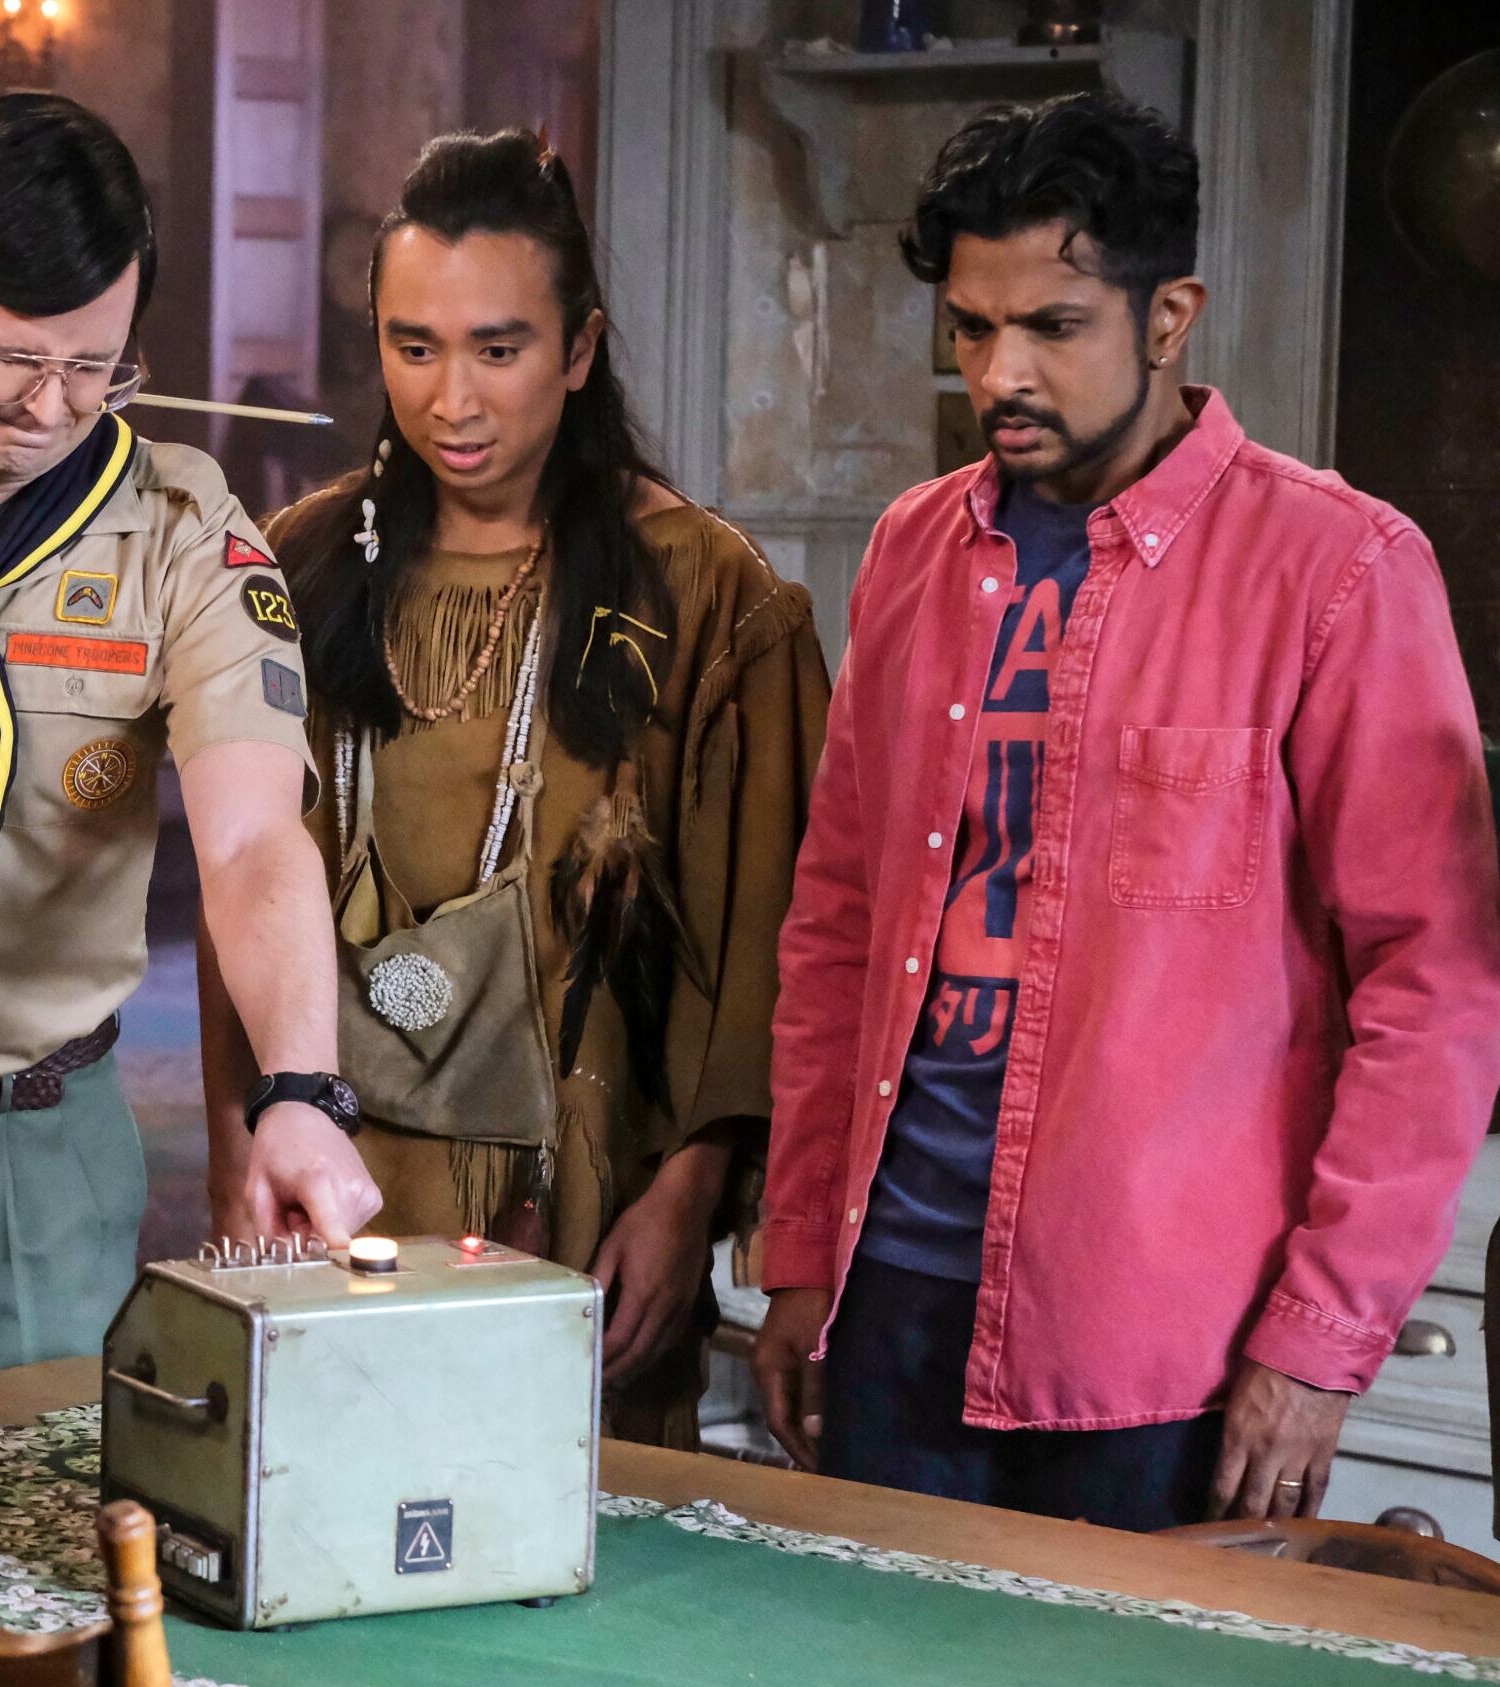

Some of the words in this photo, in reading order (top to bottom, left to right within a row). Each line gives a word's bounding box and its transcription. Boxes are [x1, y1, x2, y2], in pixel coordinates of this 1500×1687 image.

[248, 590, 296, 630] 123
[12, 641, 69, 659] PINECONE
[76, 646, 140, 666] TROOPERS
[929, 981, 1011, 1056] タリ
